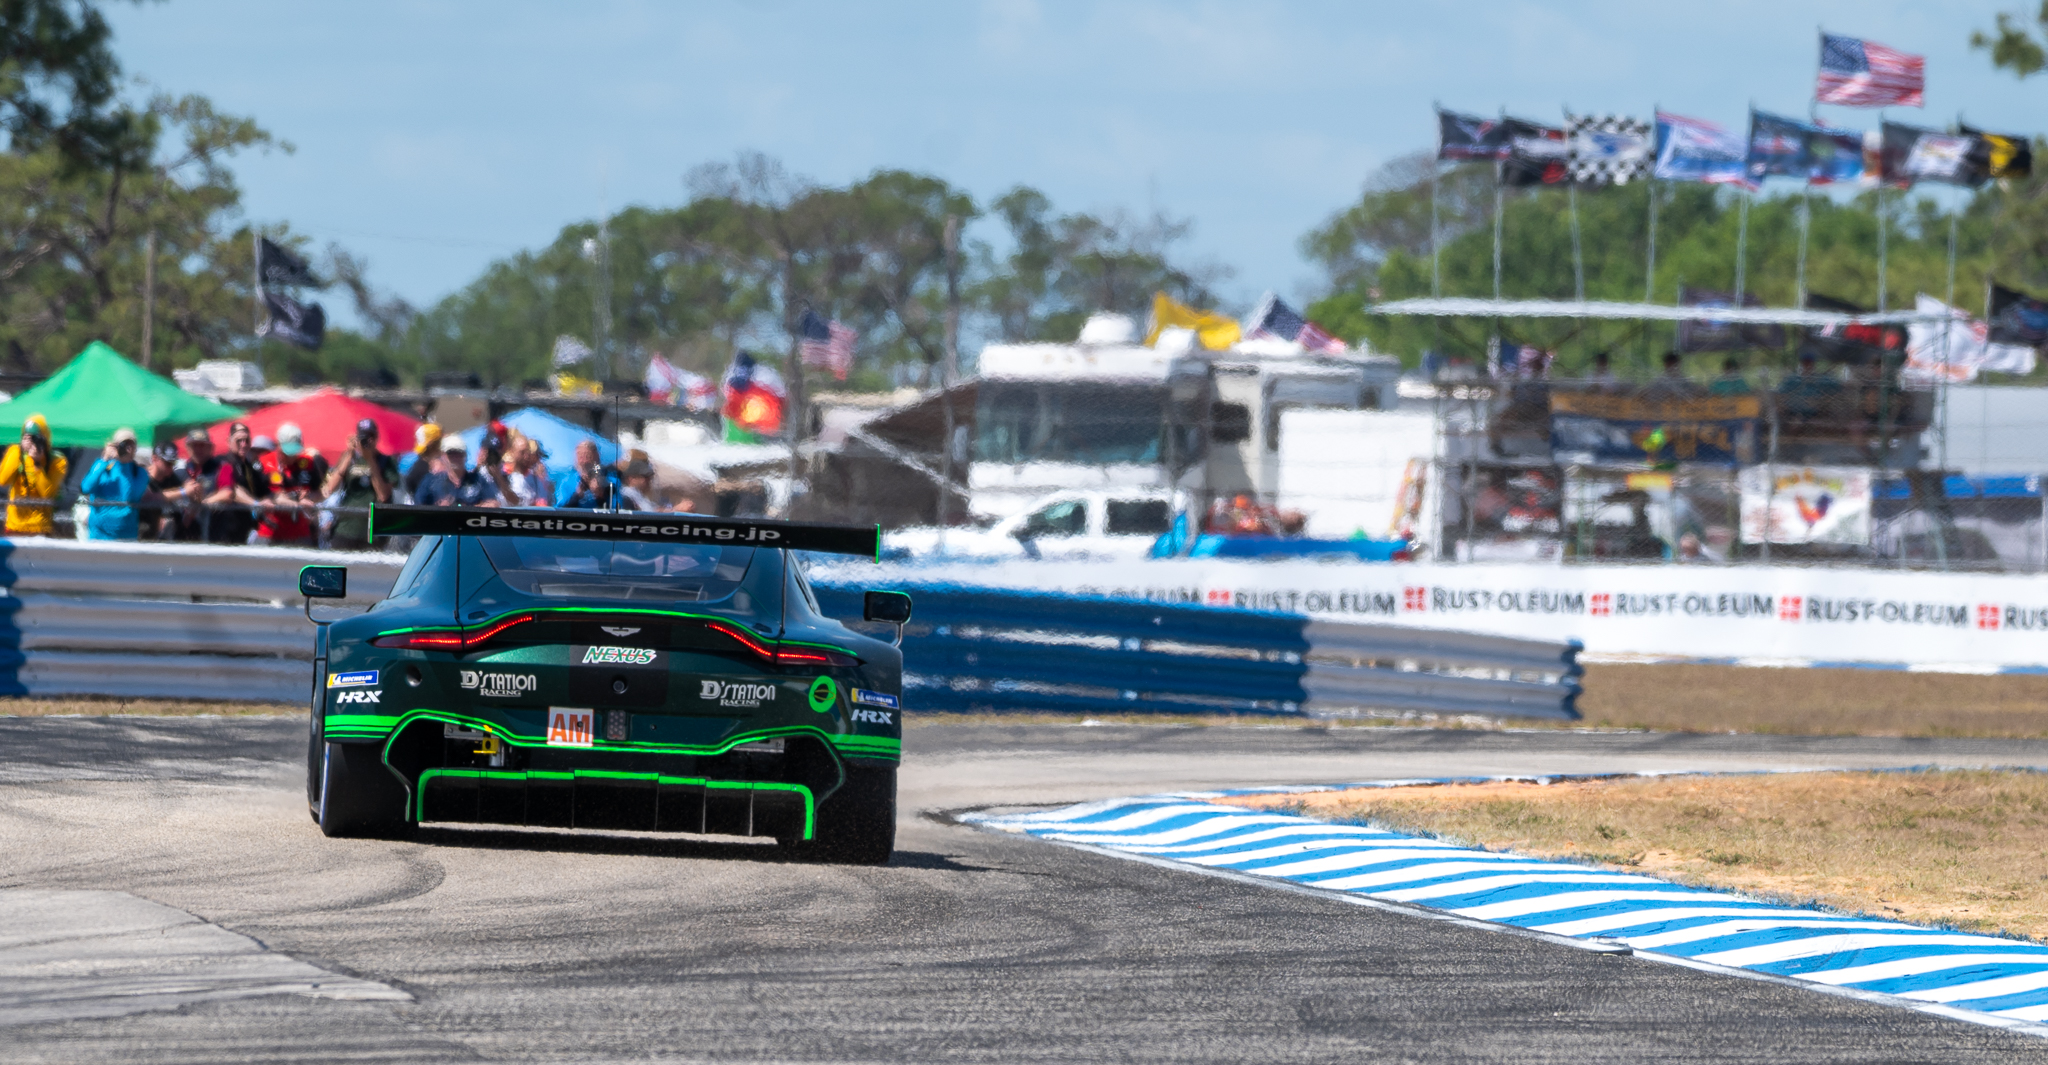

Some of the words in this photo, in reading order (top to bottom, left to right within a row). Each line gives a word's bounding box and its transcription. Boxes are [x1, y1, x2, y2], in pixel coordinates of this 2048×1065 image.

[466, 515, 780, 541] dstation-racing.jp
[582, 646, 657, 664] NEXUS
[460, 670, 537, 691] D'STATION
[337, 690, 382, 703] HRX
[480, 688, 521, 697] RACING
[699, 680, 776, 701] D'STATION
[720, 699, 760, 708] RACING
[865, 695, 893, 704] MICHELIN
[851, 709, 893, 725] HRX
[550, 713, 591, 743] AM
